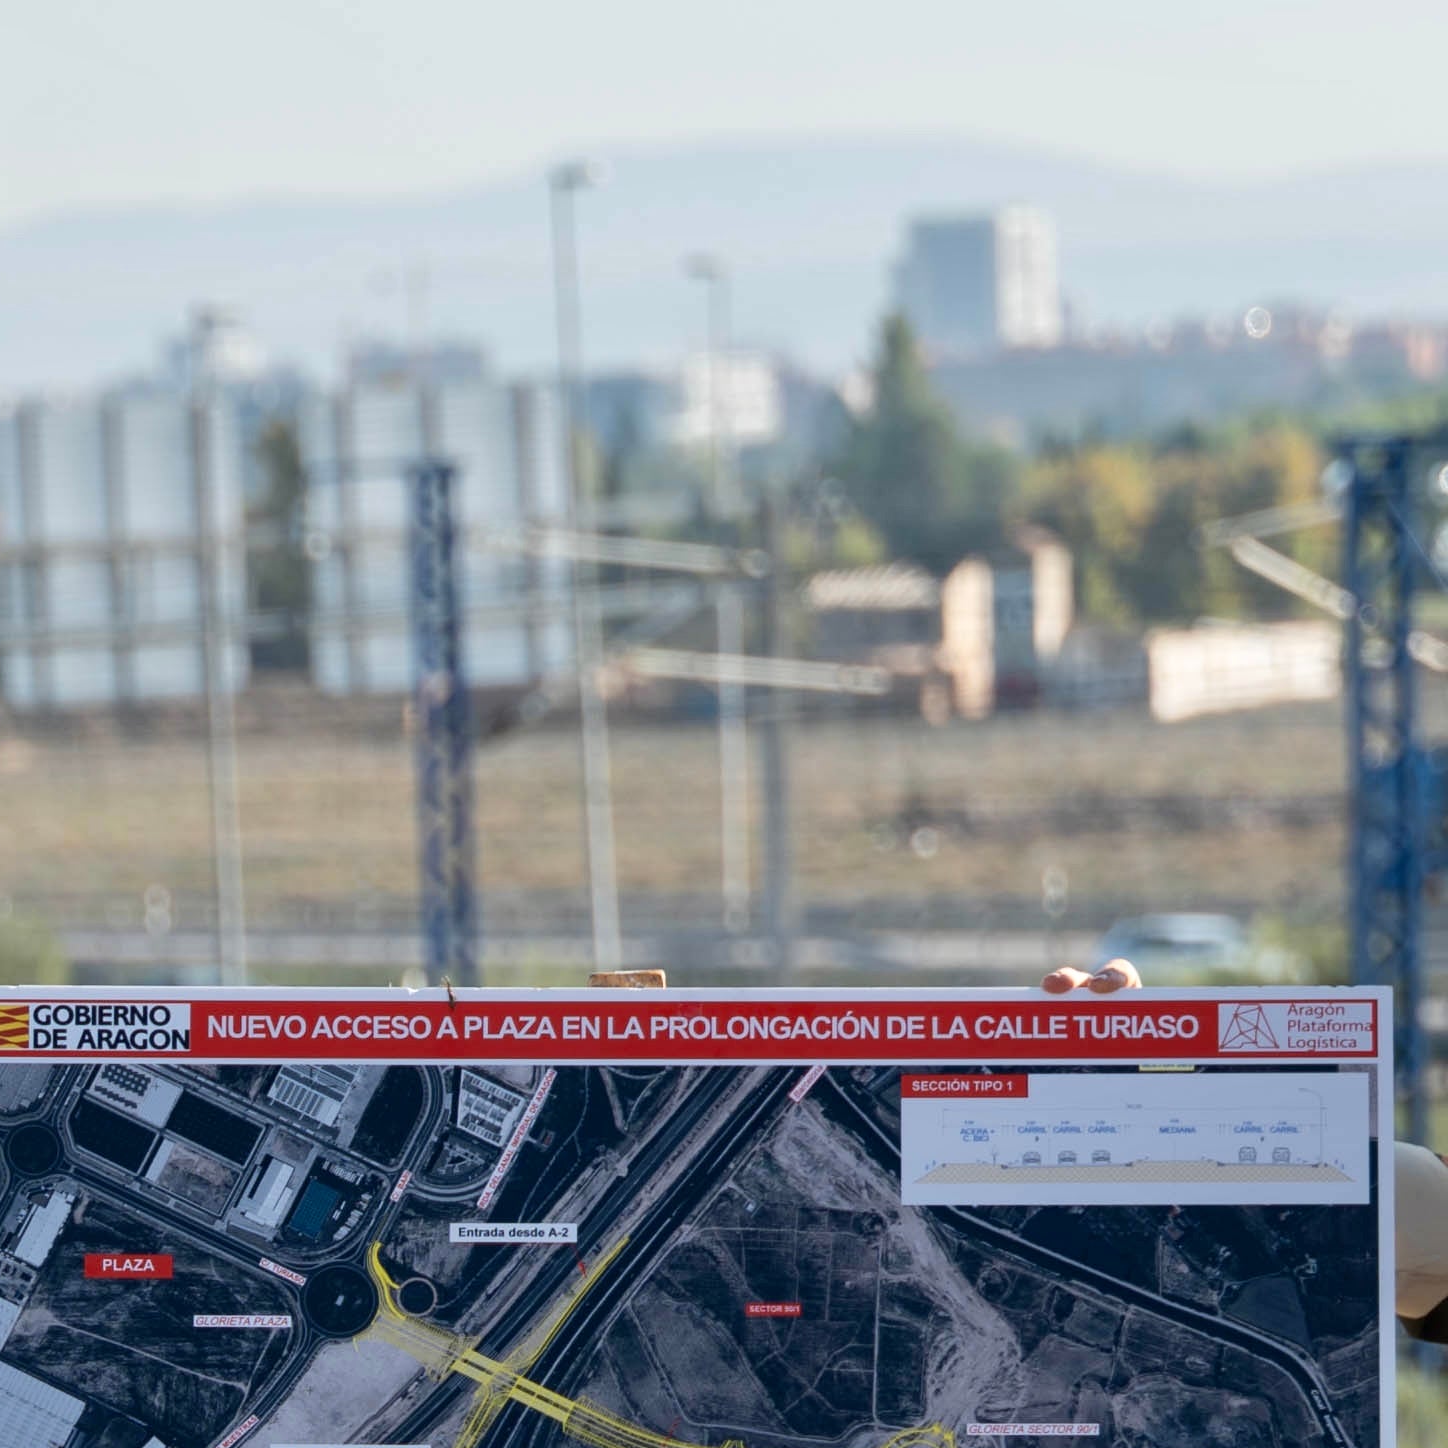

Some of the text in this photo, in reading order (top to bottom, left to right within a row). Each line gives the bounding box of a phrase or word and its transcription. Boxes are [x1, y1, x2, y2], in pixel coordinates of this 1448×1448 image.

[33, 1005, 171, 1027] GOBIERNO
[1287, 1002, 1345, 1020] Aragón
[207, 1010, 1199, 1040] NUEVO ACCESO A PLAZA EN LA PROLONGACIÓN DE LA CALLE TURIASO
[1288, 1018, 1373, 1033] Plataforma
[33, 1028, 190, 1050] DE ARAGON
[1288, 1034, 1357, 1053] Logística
[912, 1078, 1013, 1092] SECCIÓN TIPO 1
[458, 1227, 569, 1238] Entrada desde A-2
[102, 1258, 154, 1272] PLAZA
[749, 1304, 782, 1313] SECTOR
[195, 1316, 289, 1326] GLORIETA PLAZA
[968, 1424, 1025, 1434] GLORIETA
[1028, 1424, 1073, 1434] SECTOR
